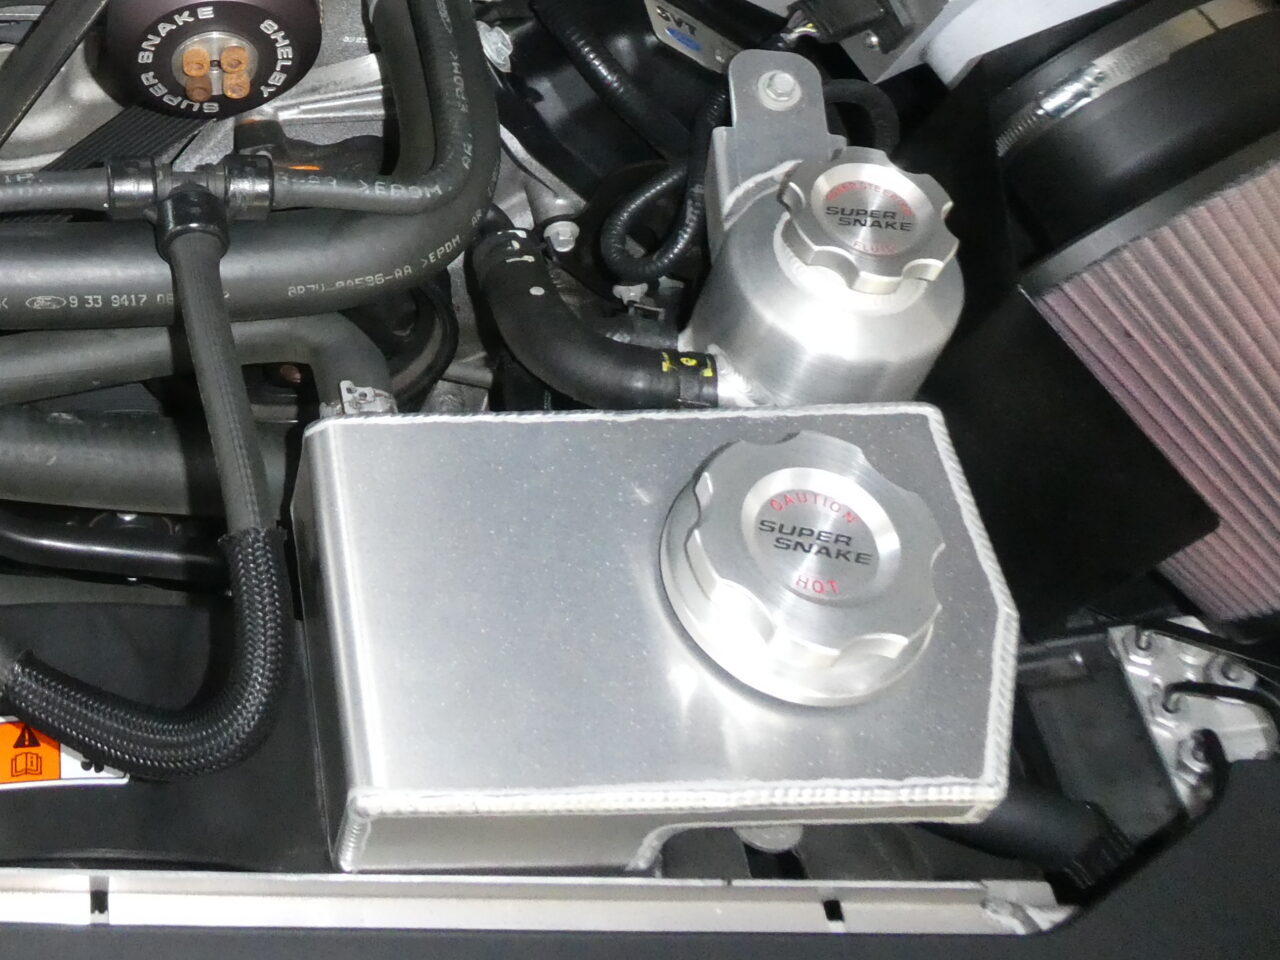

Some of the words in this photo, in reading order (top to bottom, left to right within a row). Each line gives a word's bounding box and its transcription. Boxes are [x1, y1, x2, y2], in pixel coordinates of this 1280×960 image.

[138, 6, 215, 64] SNAKE
[260, 19, 293, 98] SHELBY
[141, 71, 220, 113] SUPER
[826, 206, 897, 220] SUPER
[837, 217, 913, 232] SNAKE
[84, 294, 103, 307] 33
[111, 293, 147, 307] 9417
[769, 492, 858, 523] CAUTION
[758, 519, 853, 547] SUPER
[773, 537, 873, 566] SNAKE
[795, 574, 841, 595] HOT
